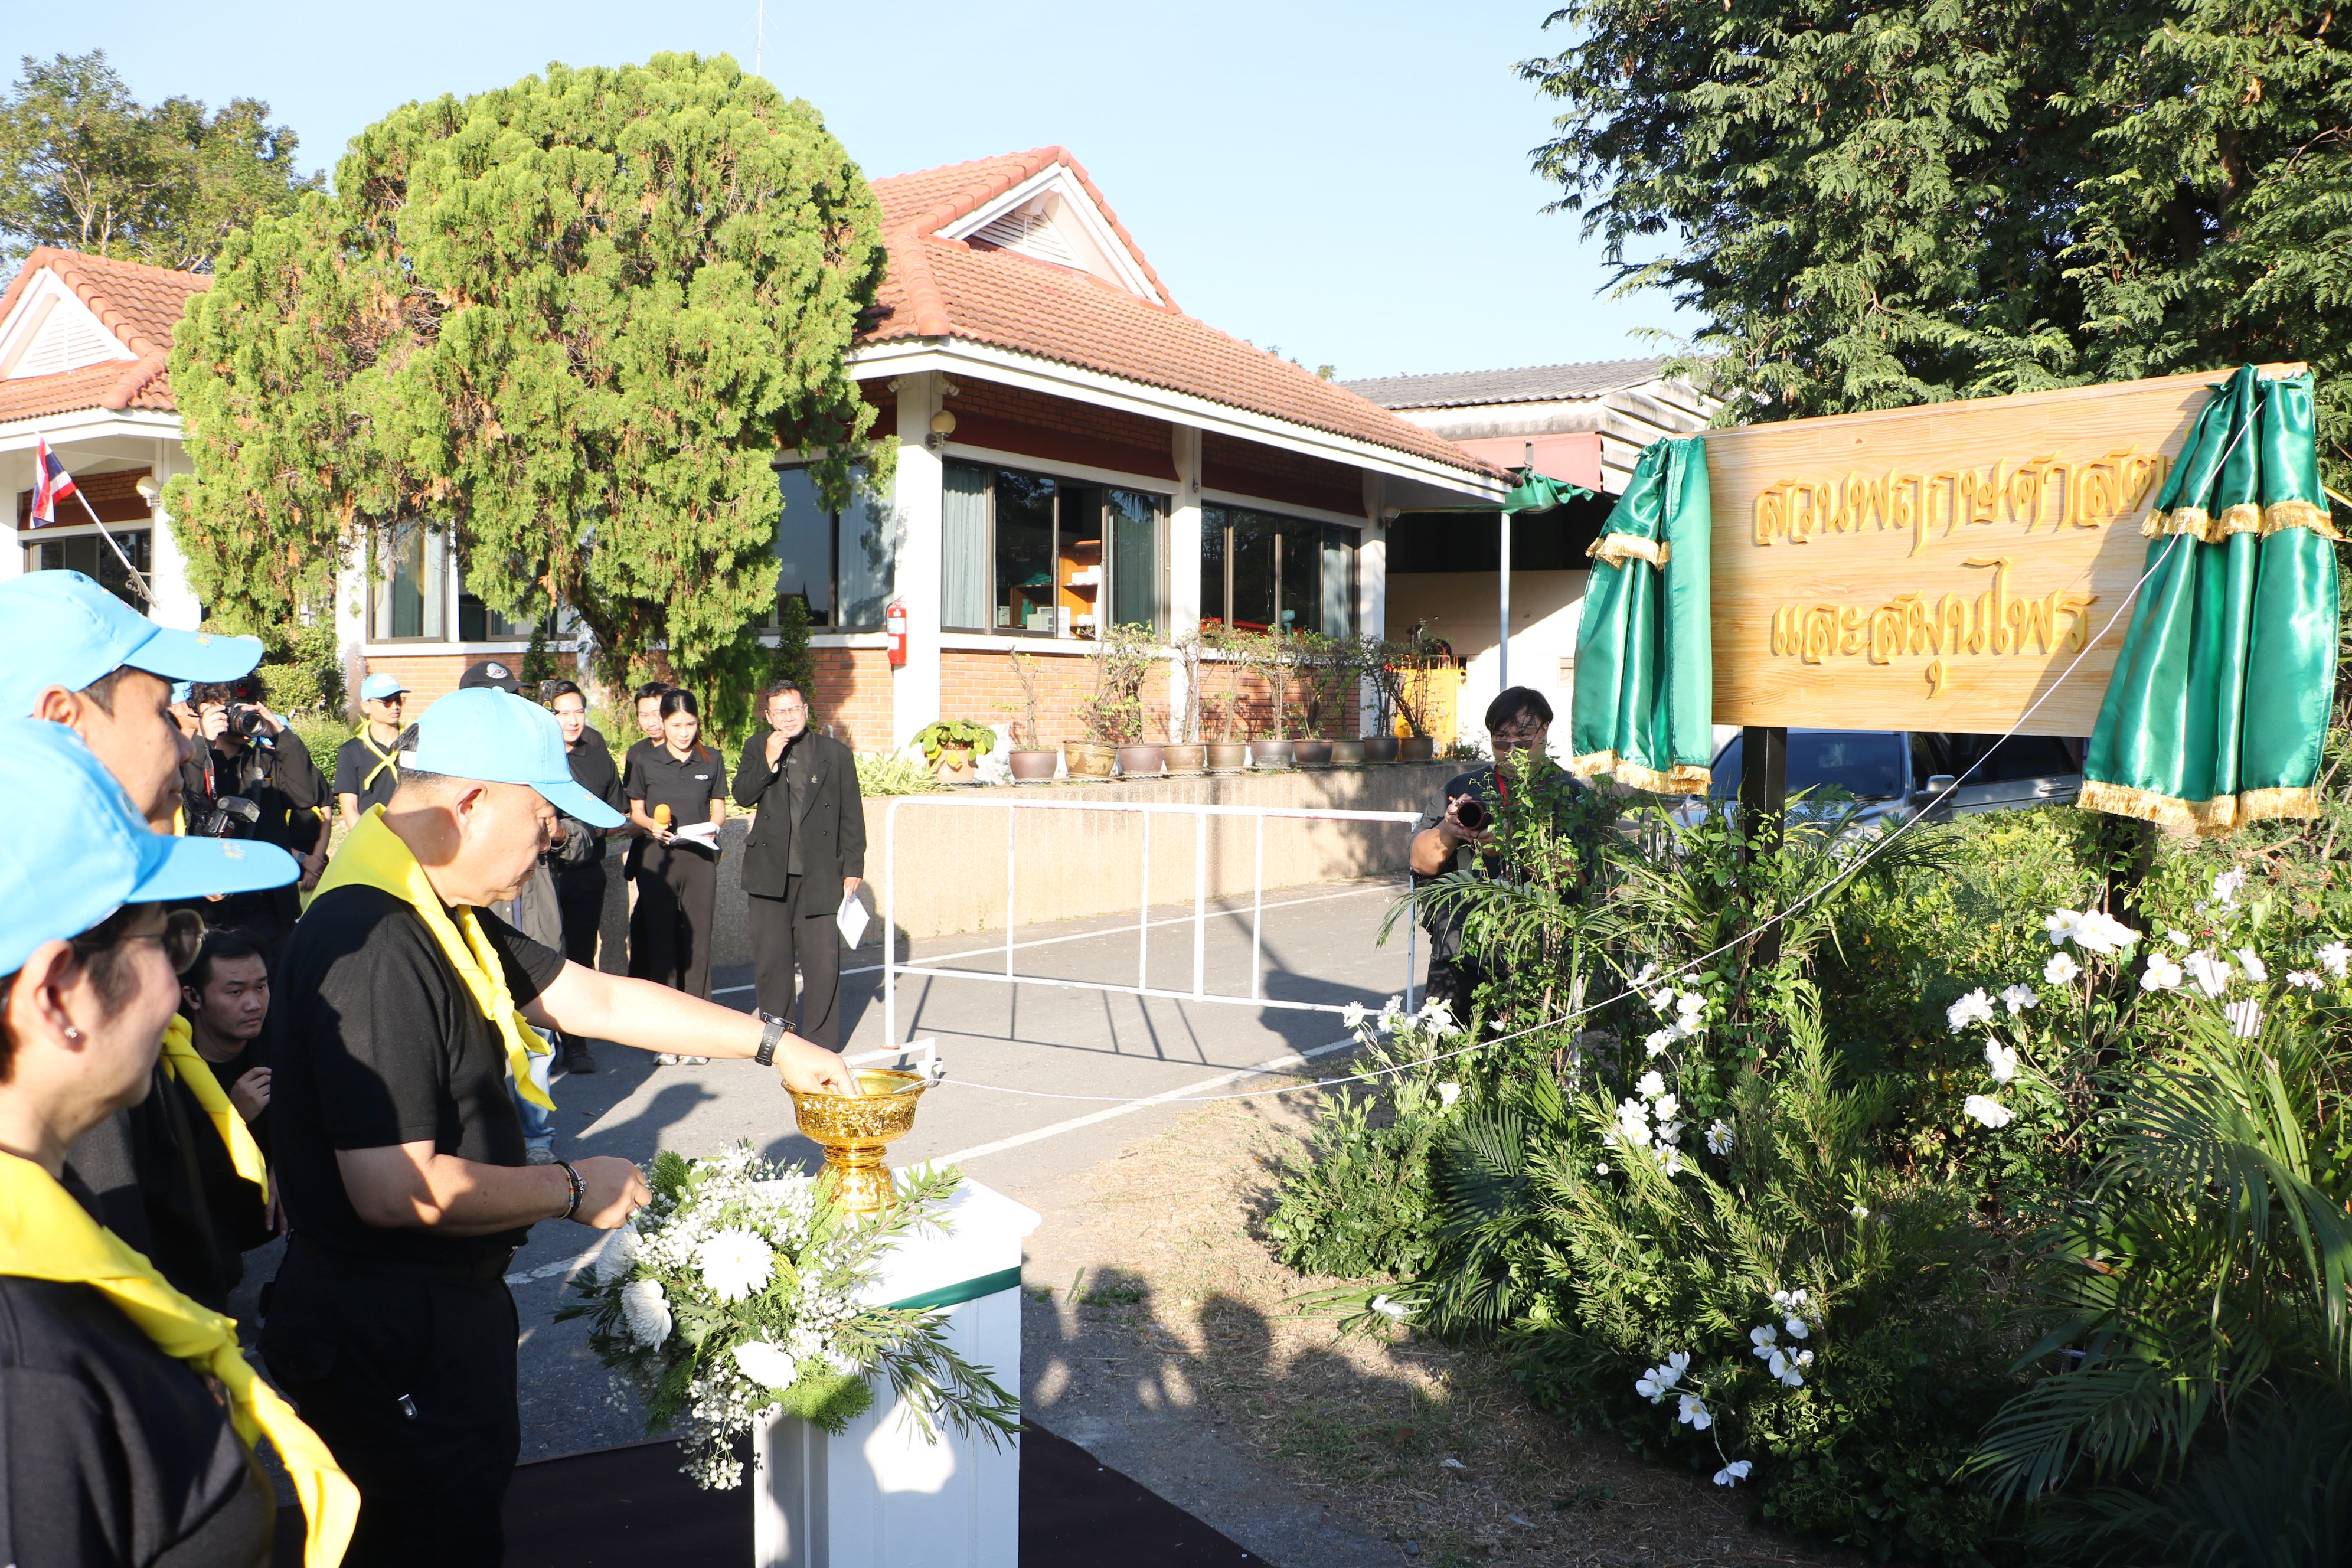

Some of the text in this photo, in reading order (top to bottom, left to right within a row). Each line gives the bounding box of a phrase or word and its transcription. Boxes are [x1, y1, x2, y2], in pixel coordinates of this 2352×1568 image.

[1753, 422, 2194, 557] สวนพฤกษศาสต
[1773, 557, 2099, 697] และสมุนไพร
